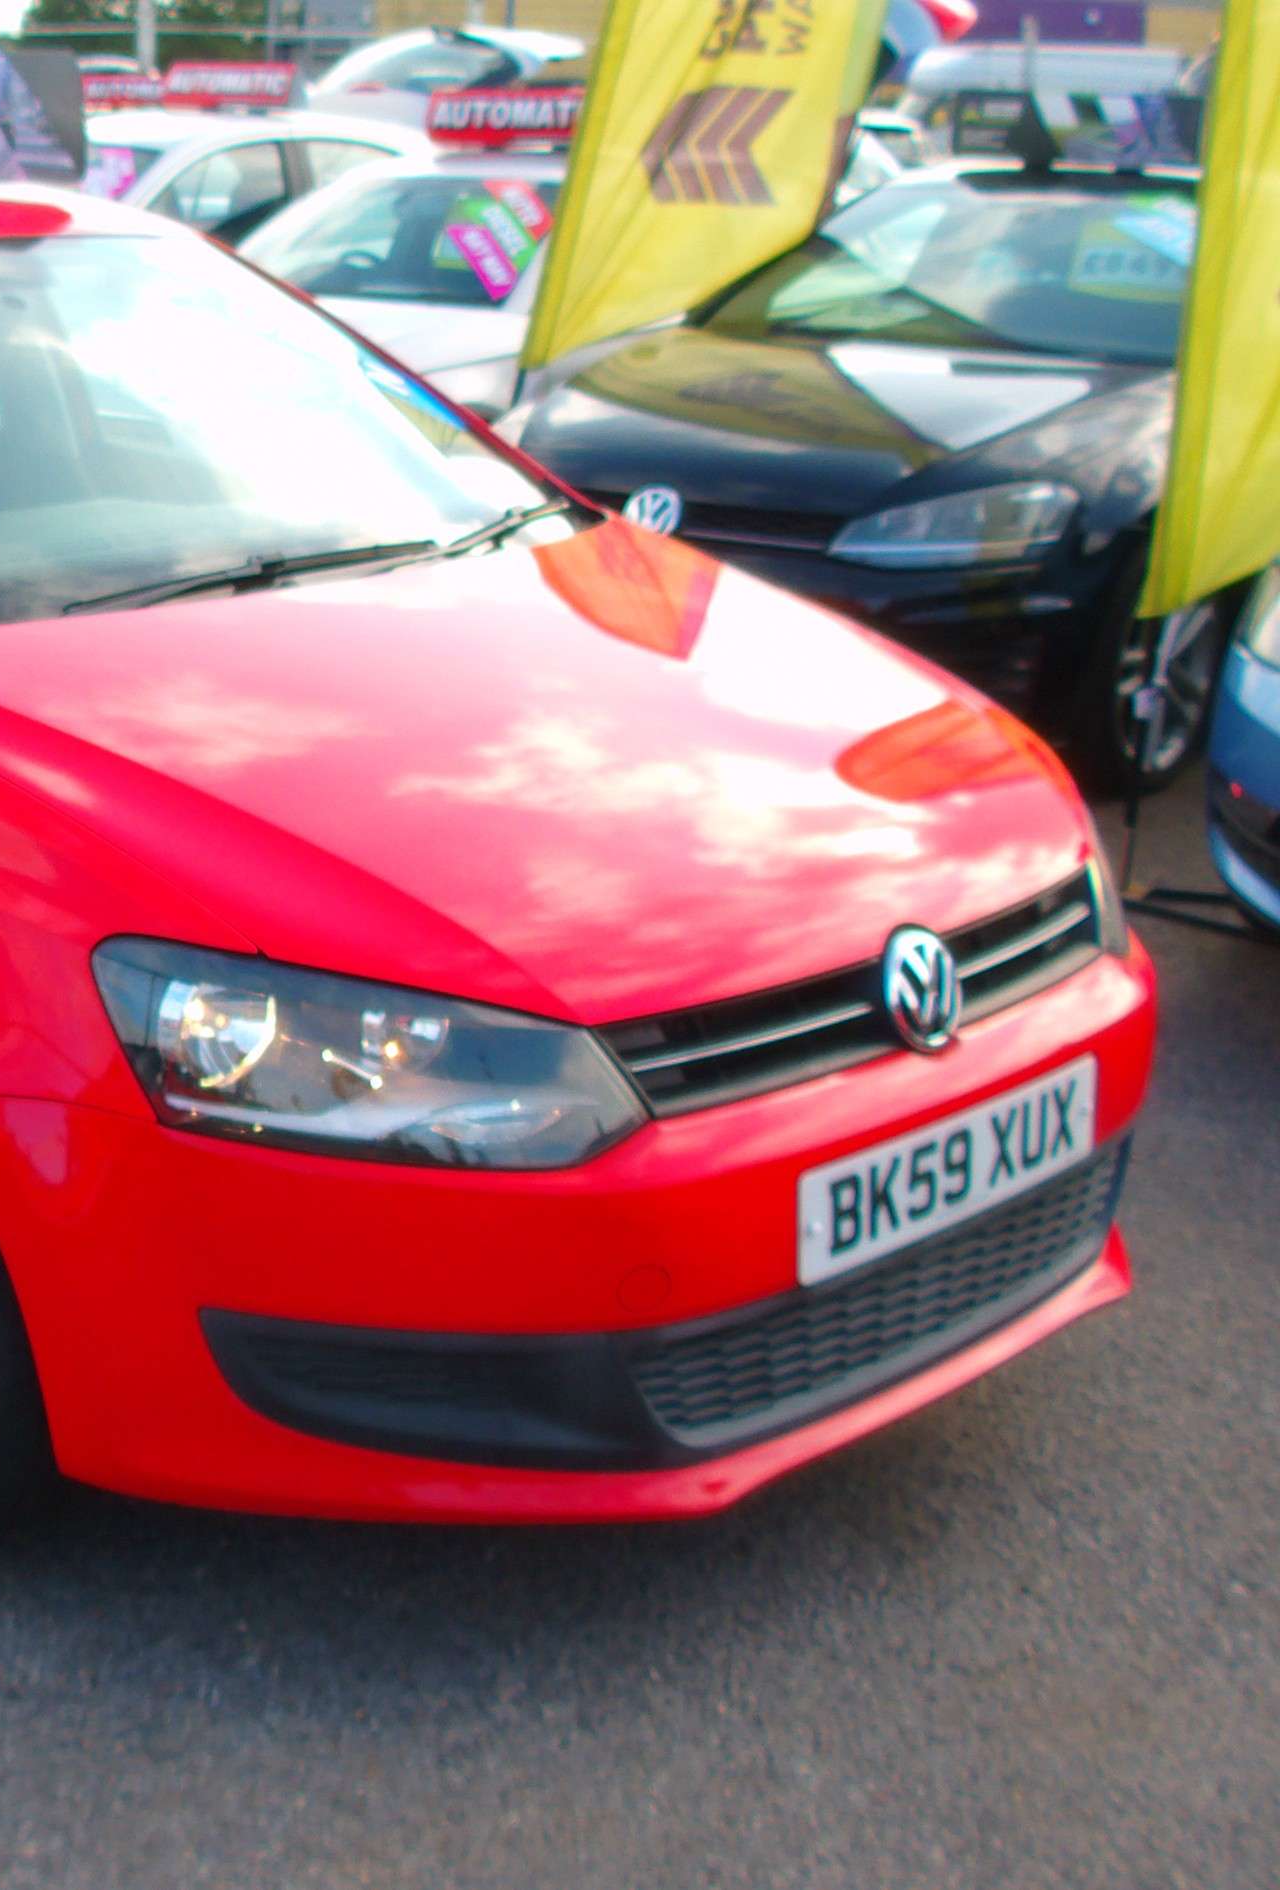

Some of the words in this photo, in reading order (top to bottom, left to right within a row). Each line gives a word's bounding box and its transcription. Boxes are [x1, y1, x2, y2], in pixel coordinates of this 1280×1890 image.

[170, 70, 289, 97] AUTOMATIC
[830, 1126, 974, 1257] BK59
[989, 1079, 1077, 1188] XUX
